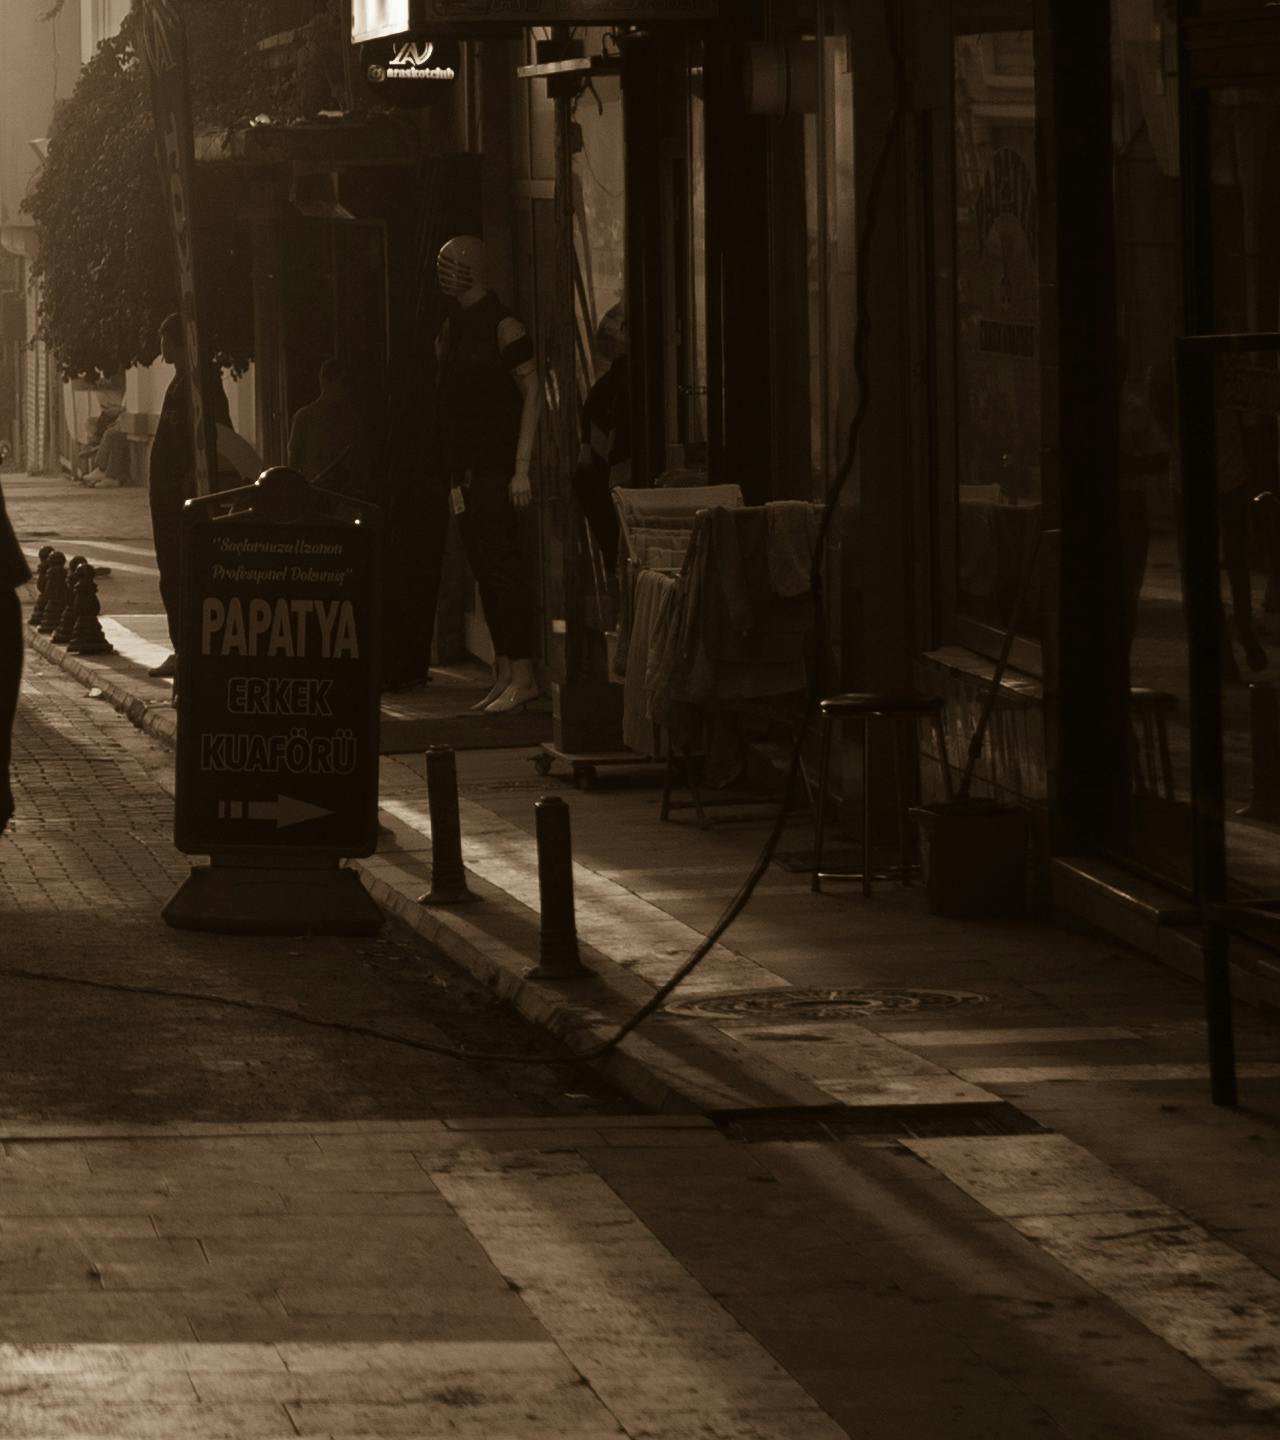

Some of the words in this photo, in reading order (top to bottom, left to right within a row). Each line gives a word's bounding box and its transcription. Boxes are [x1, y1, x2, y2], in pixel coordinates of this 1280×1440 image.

[212, 564, 288, 584] Profesyonel
[201, 597, 360, 659] PAPATYA
[226, 677, 334, 717] ERKEK
[201, 728, 358, 775] KUAFÖRÜ
